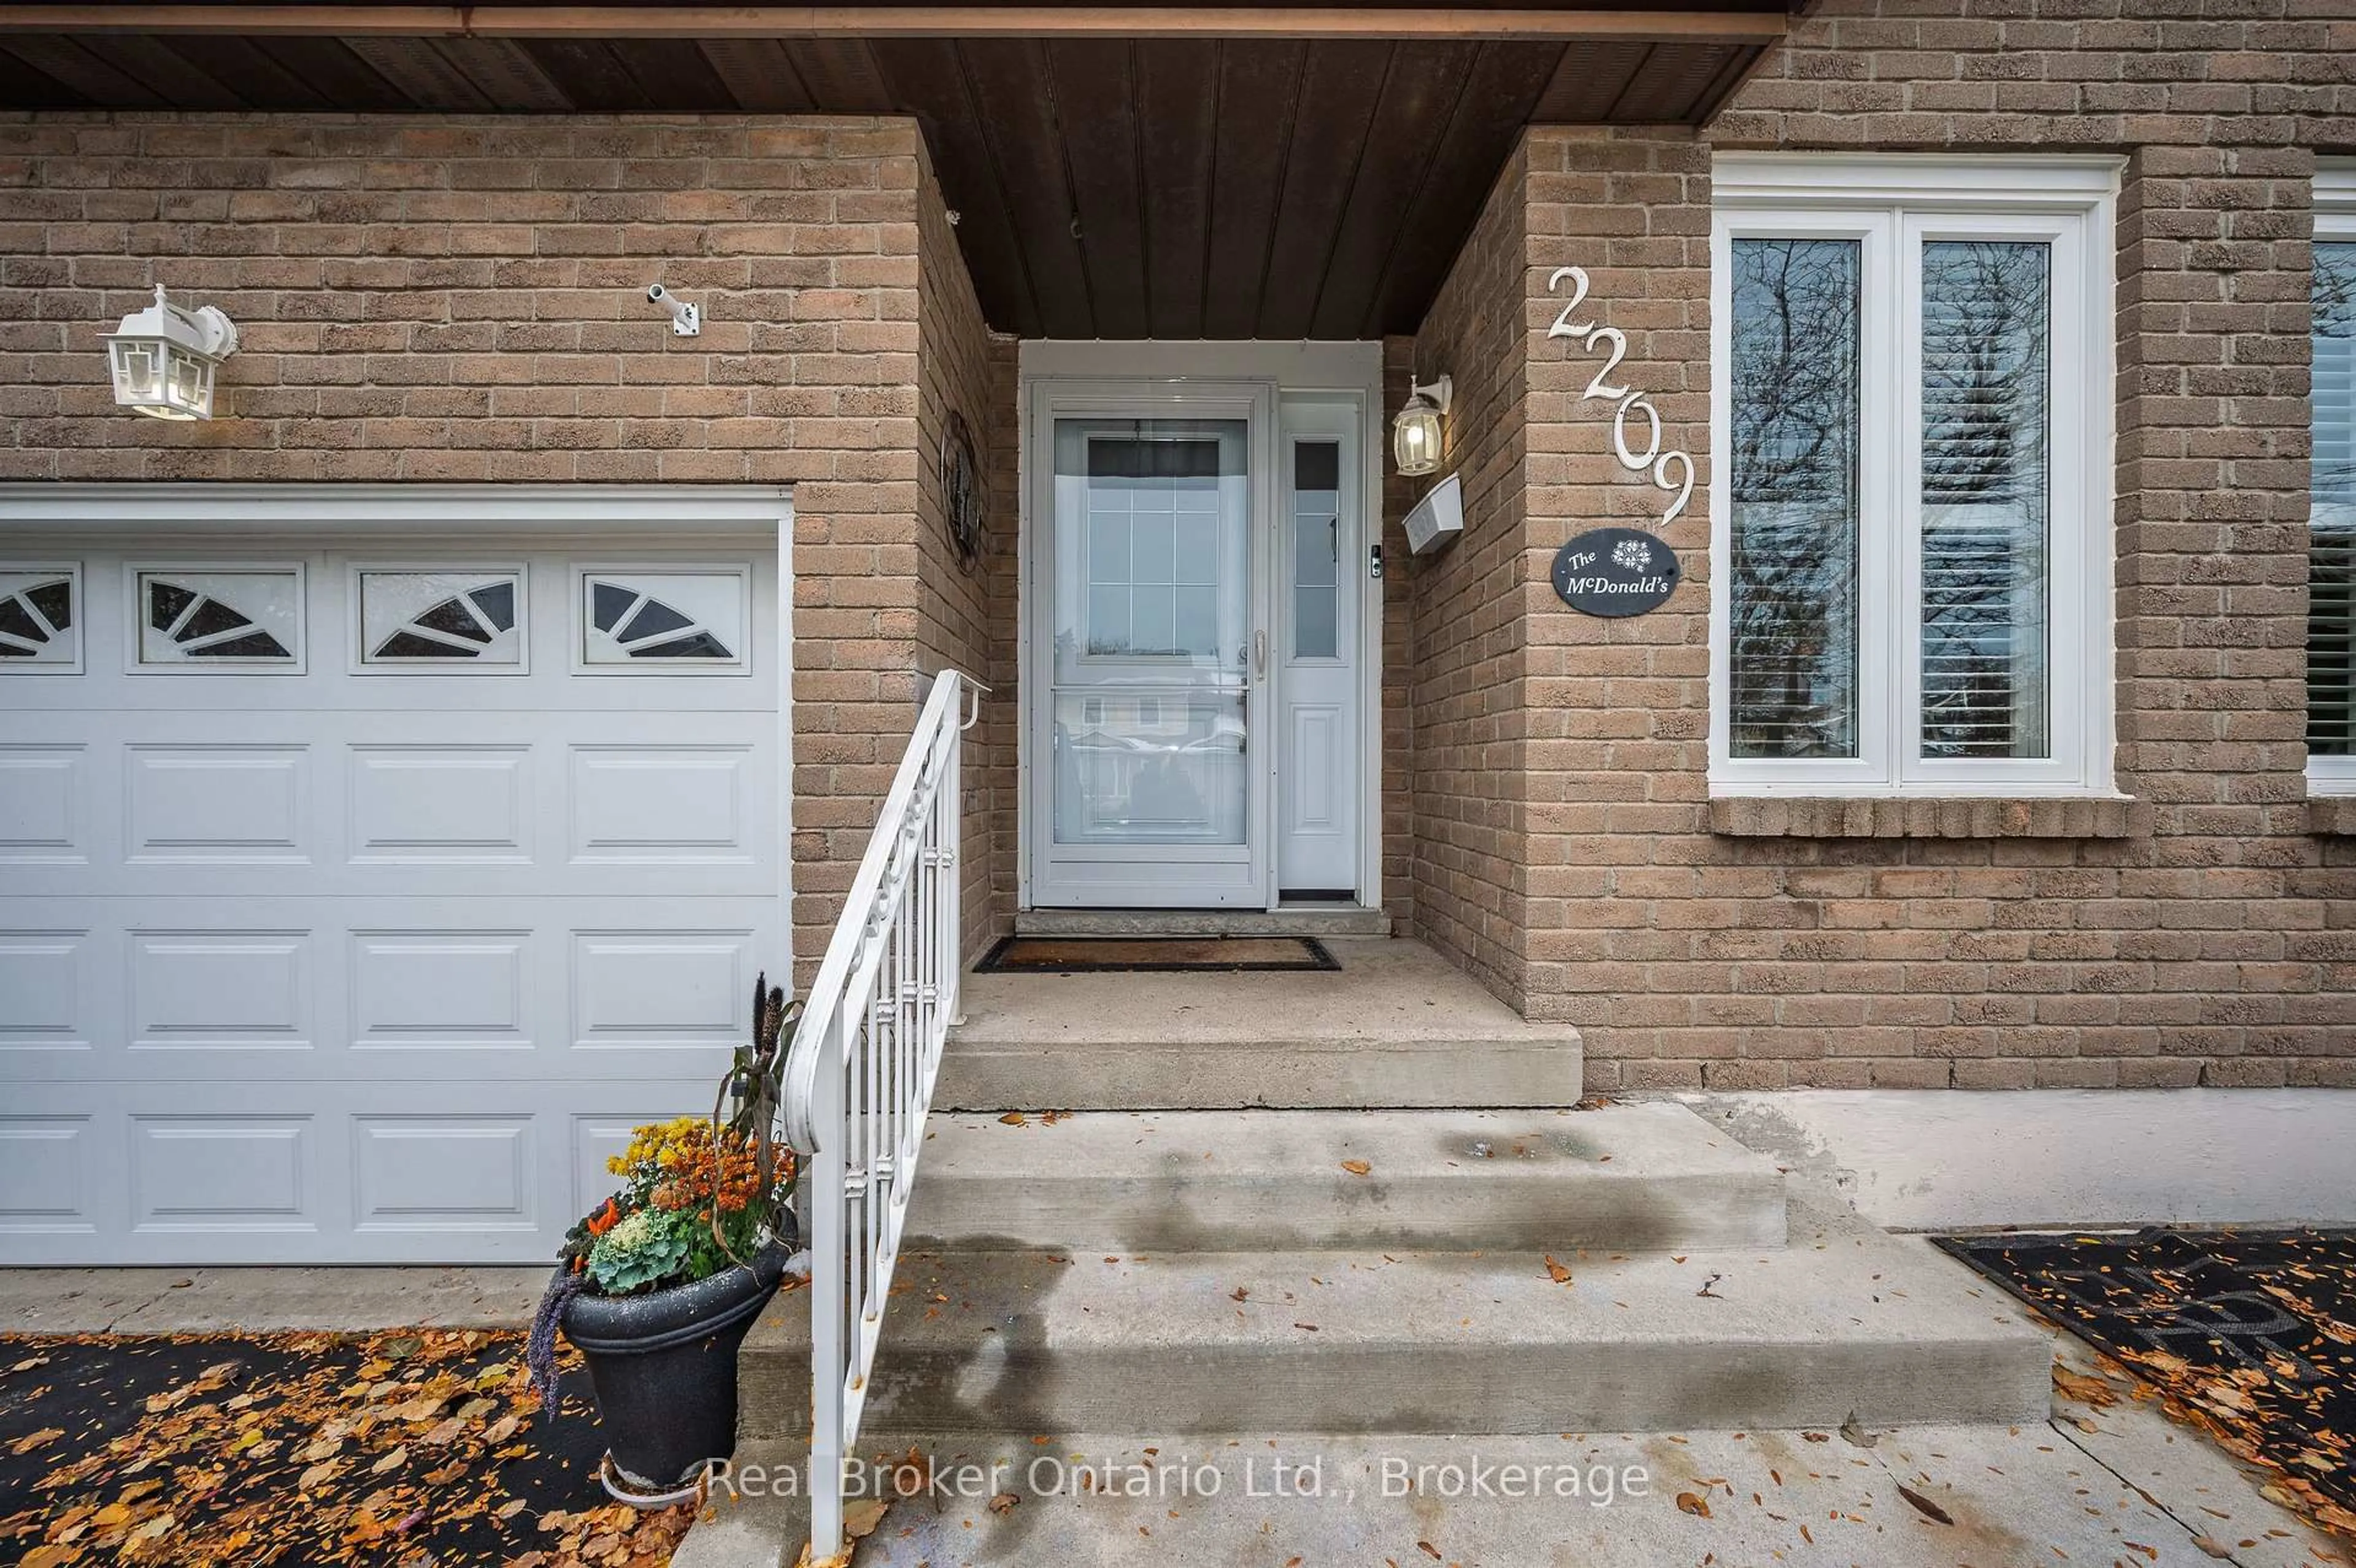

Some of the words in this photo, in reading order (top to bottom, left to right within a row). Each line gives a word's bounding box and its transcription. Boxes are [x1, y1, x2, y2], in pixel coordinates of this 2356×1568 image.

[1548, 266, 1695, 526] 2209
[1569, 551, 1596, 571] The
[1566, 576, 1669, 594] McDonald's
